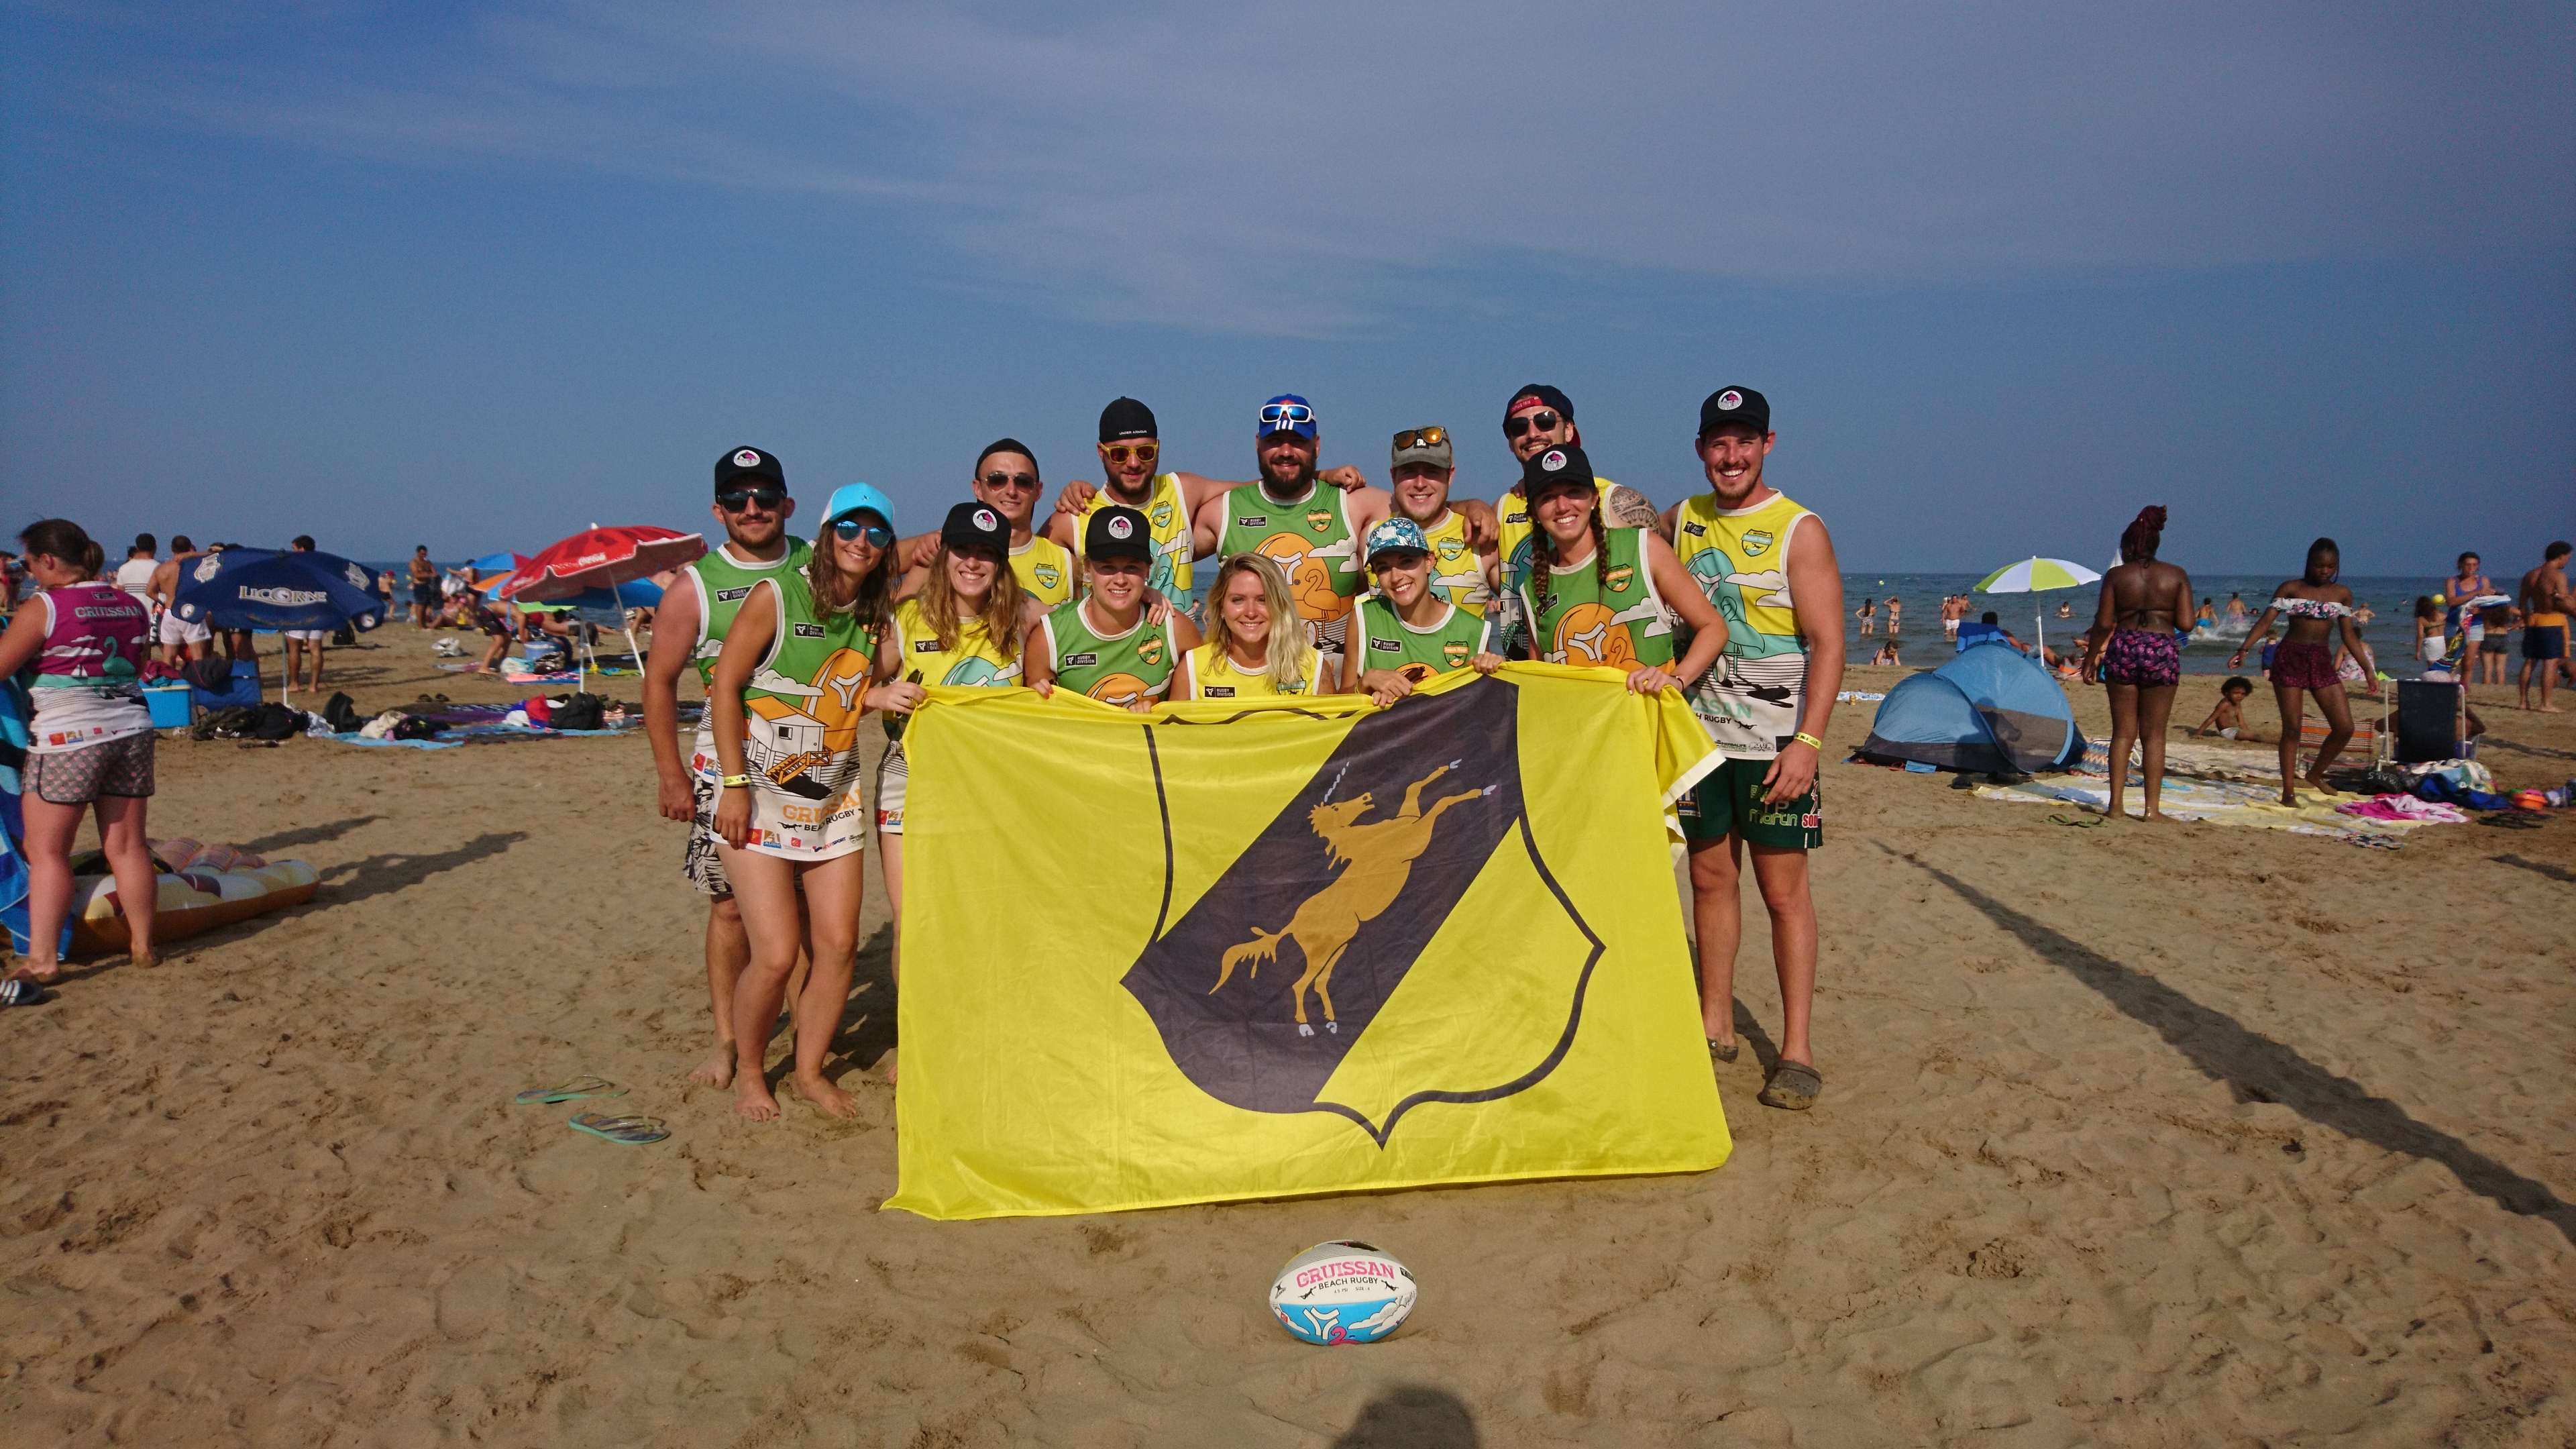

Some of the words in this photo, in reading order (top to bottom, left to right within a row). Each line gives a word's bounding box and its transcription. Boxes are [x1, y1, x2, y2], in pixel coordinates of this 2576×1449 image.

[239, 586, 327, 603] LICORNE
[1705, 714, 1731, 724] RUGBY
[826, 809, 855, 824] RUGBY
[1296, 1260, 1395, 1288] GRUISSAN
[1318, 1277, 1348, 1290] BEACH
